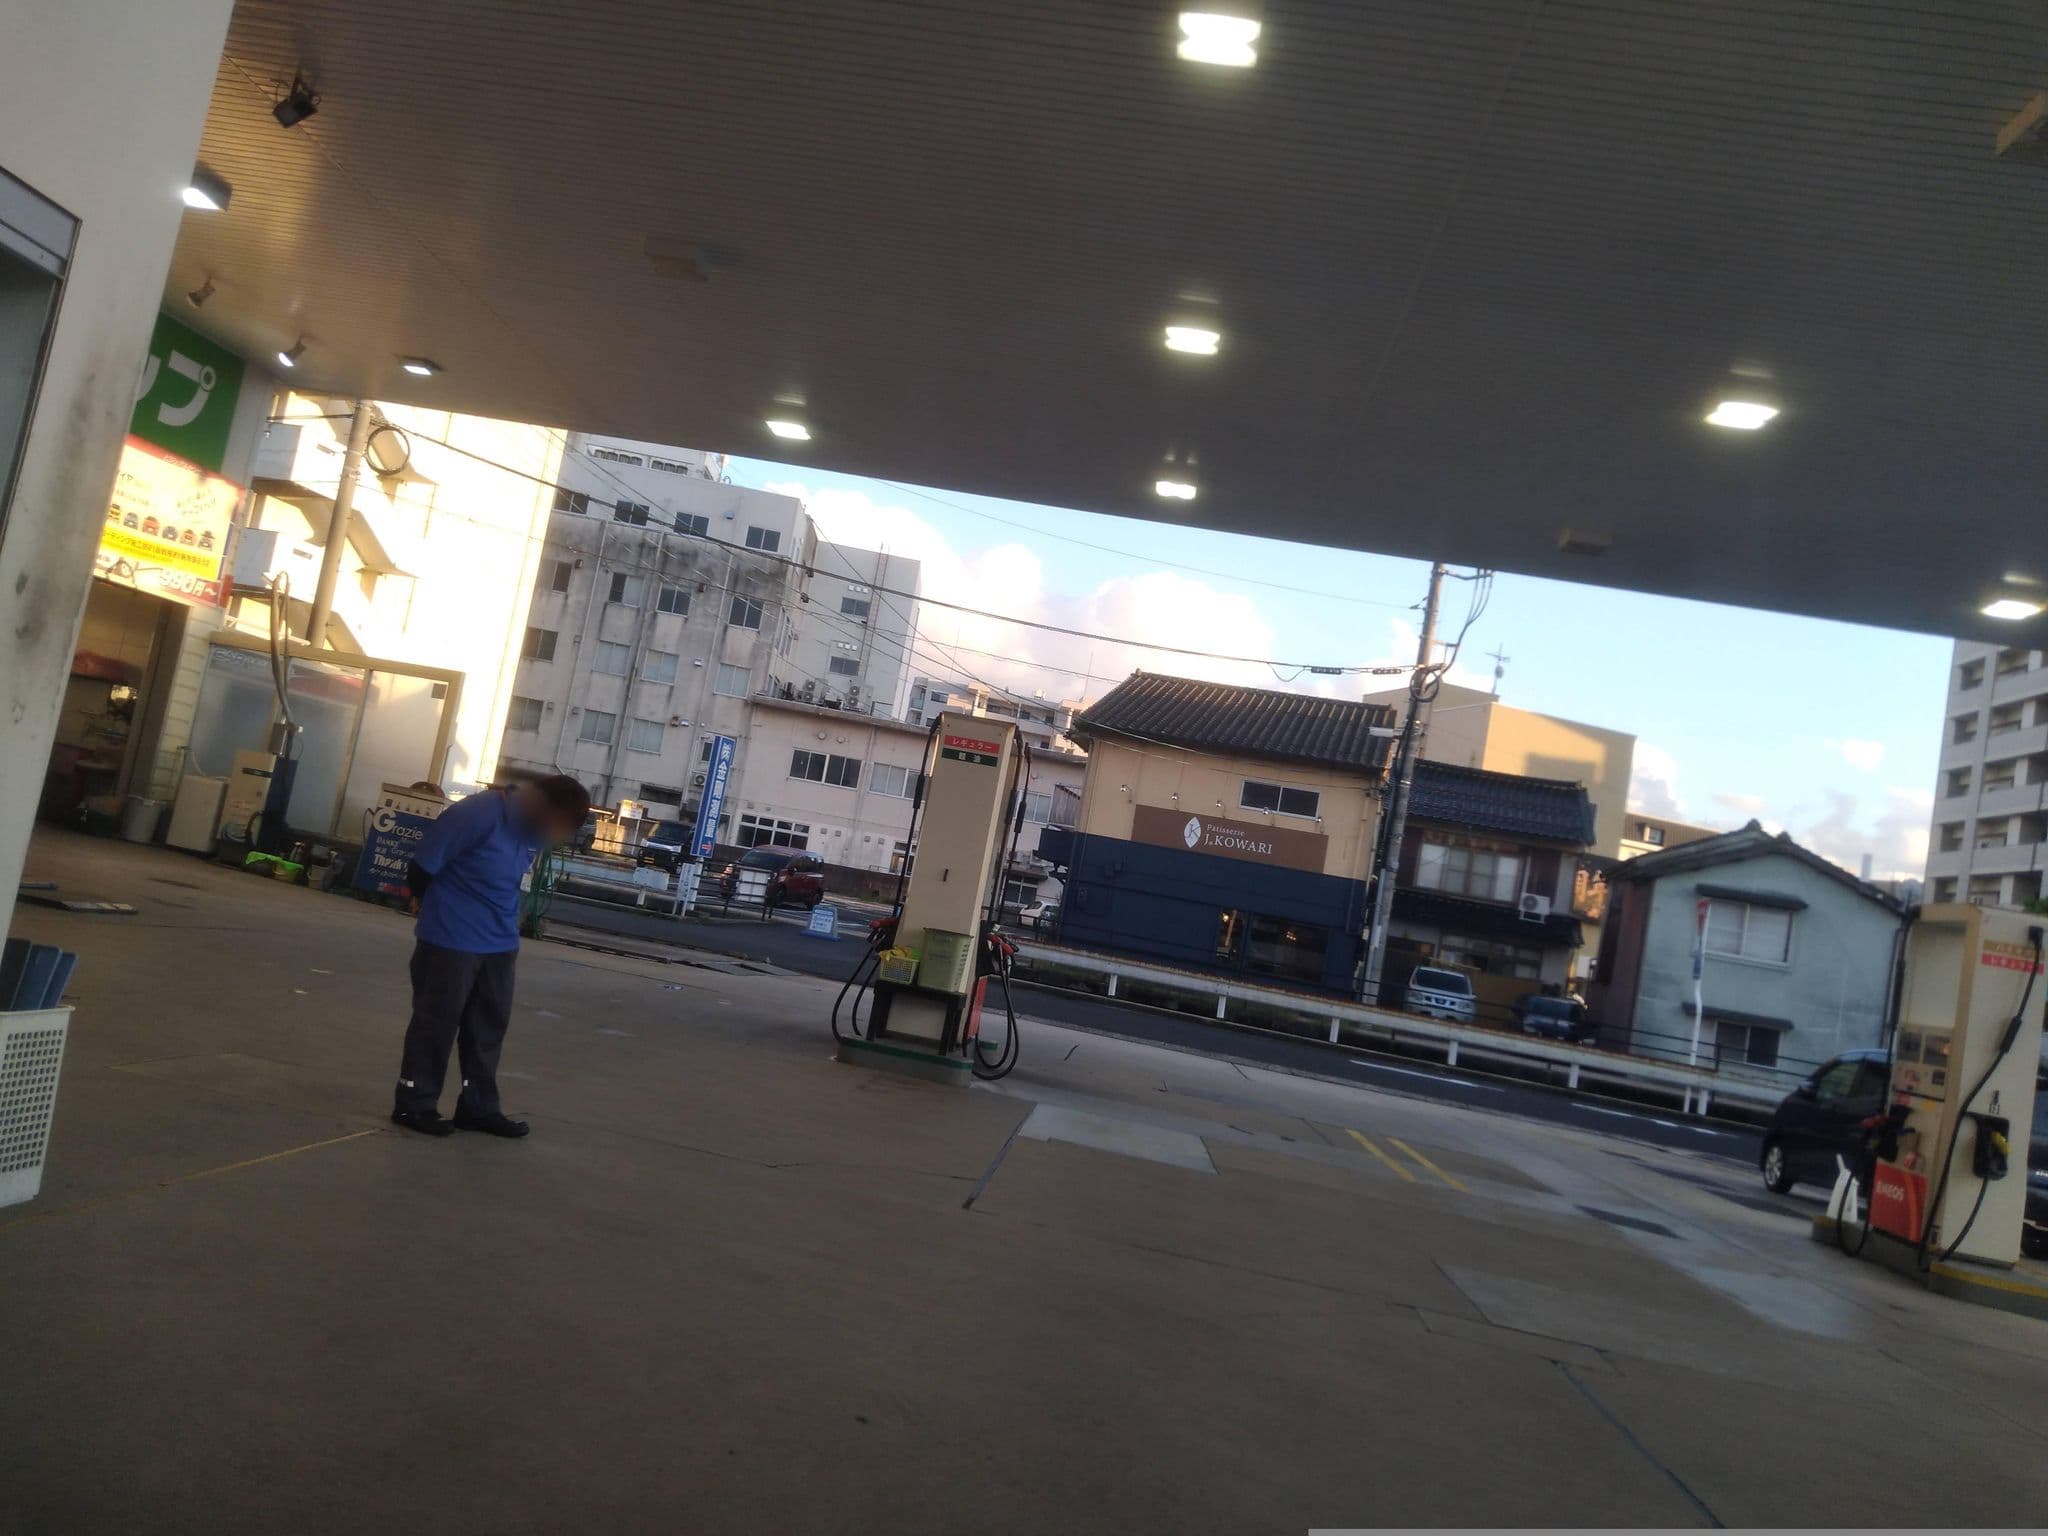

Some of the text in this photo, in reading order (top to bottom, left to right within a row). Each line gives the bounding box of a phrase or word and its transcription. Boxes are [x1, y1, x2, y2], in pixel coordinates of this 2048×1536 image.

[952, 737, 993, 749] レギュラー
[373, 807, 423, 840] Grazie
